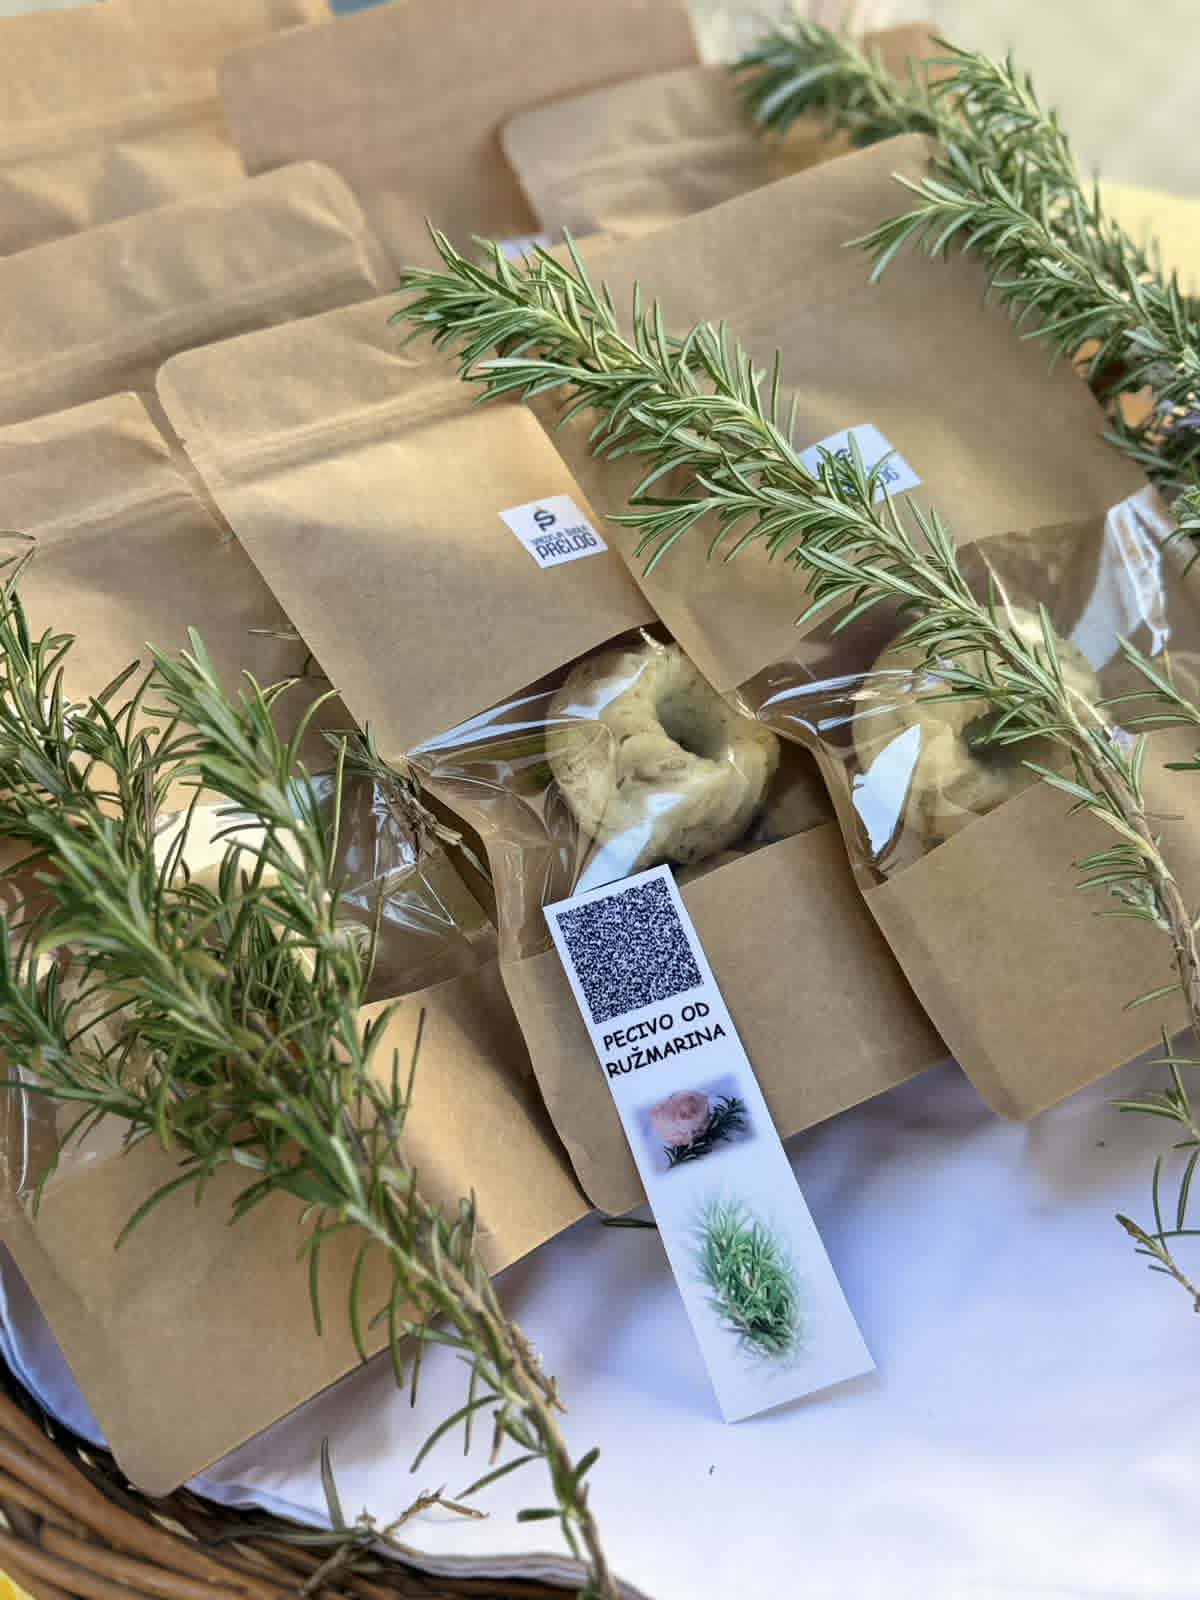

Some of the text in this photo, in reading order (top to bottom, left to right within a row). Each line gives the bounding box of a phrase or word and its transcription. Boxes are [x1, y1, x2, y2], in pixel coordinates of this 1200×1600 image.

[536, 531, 597, 560] PRELOG
[603, 1002, 710, 1051] PECIVO OD
[606, 1023, 726, 1078] RUŽMARINA
